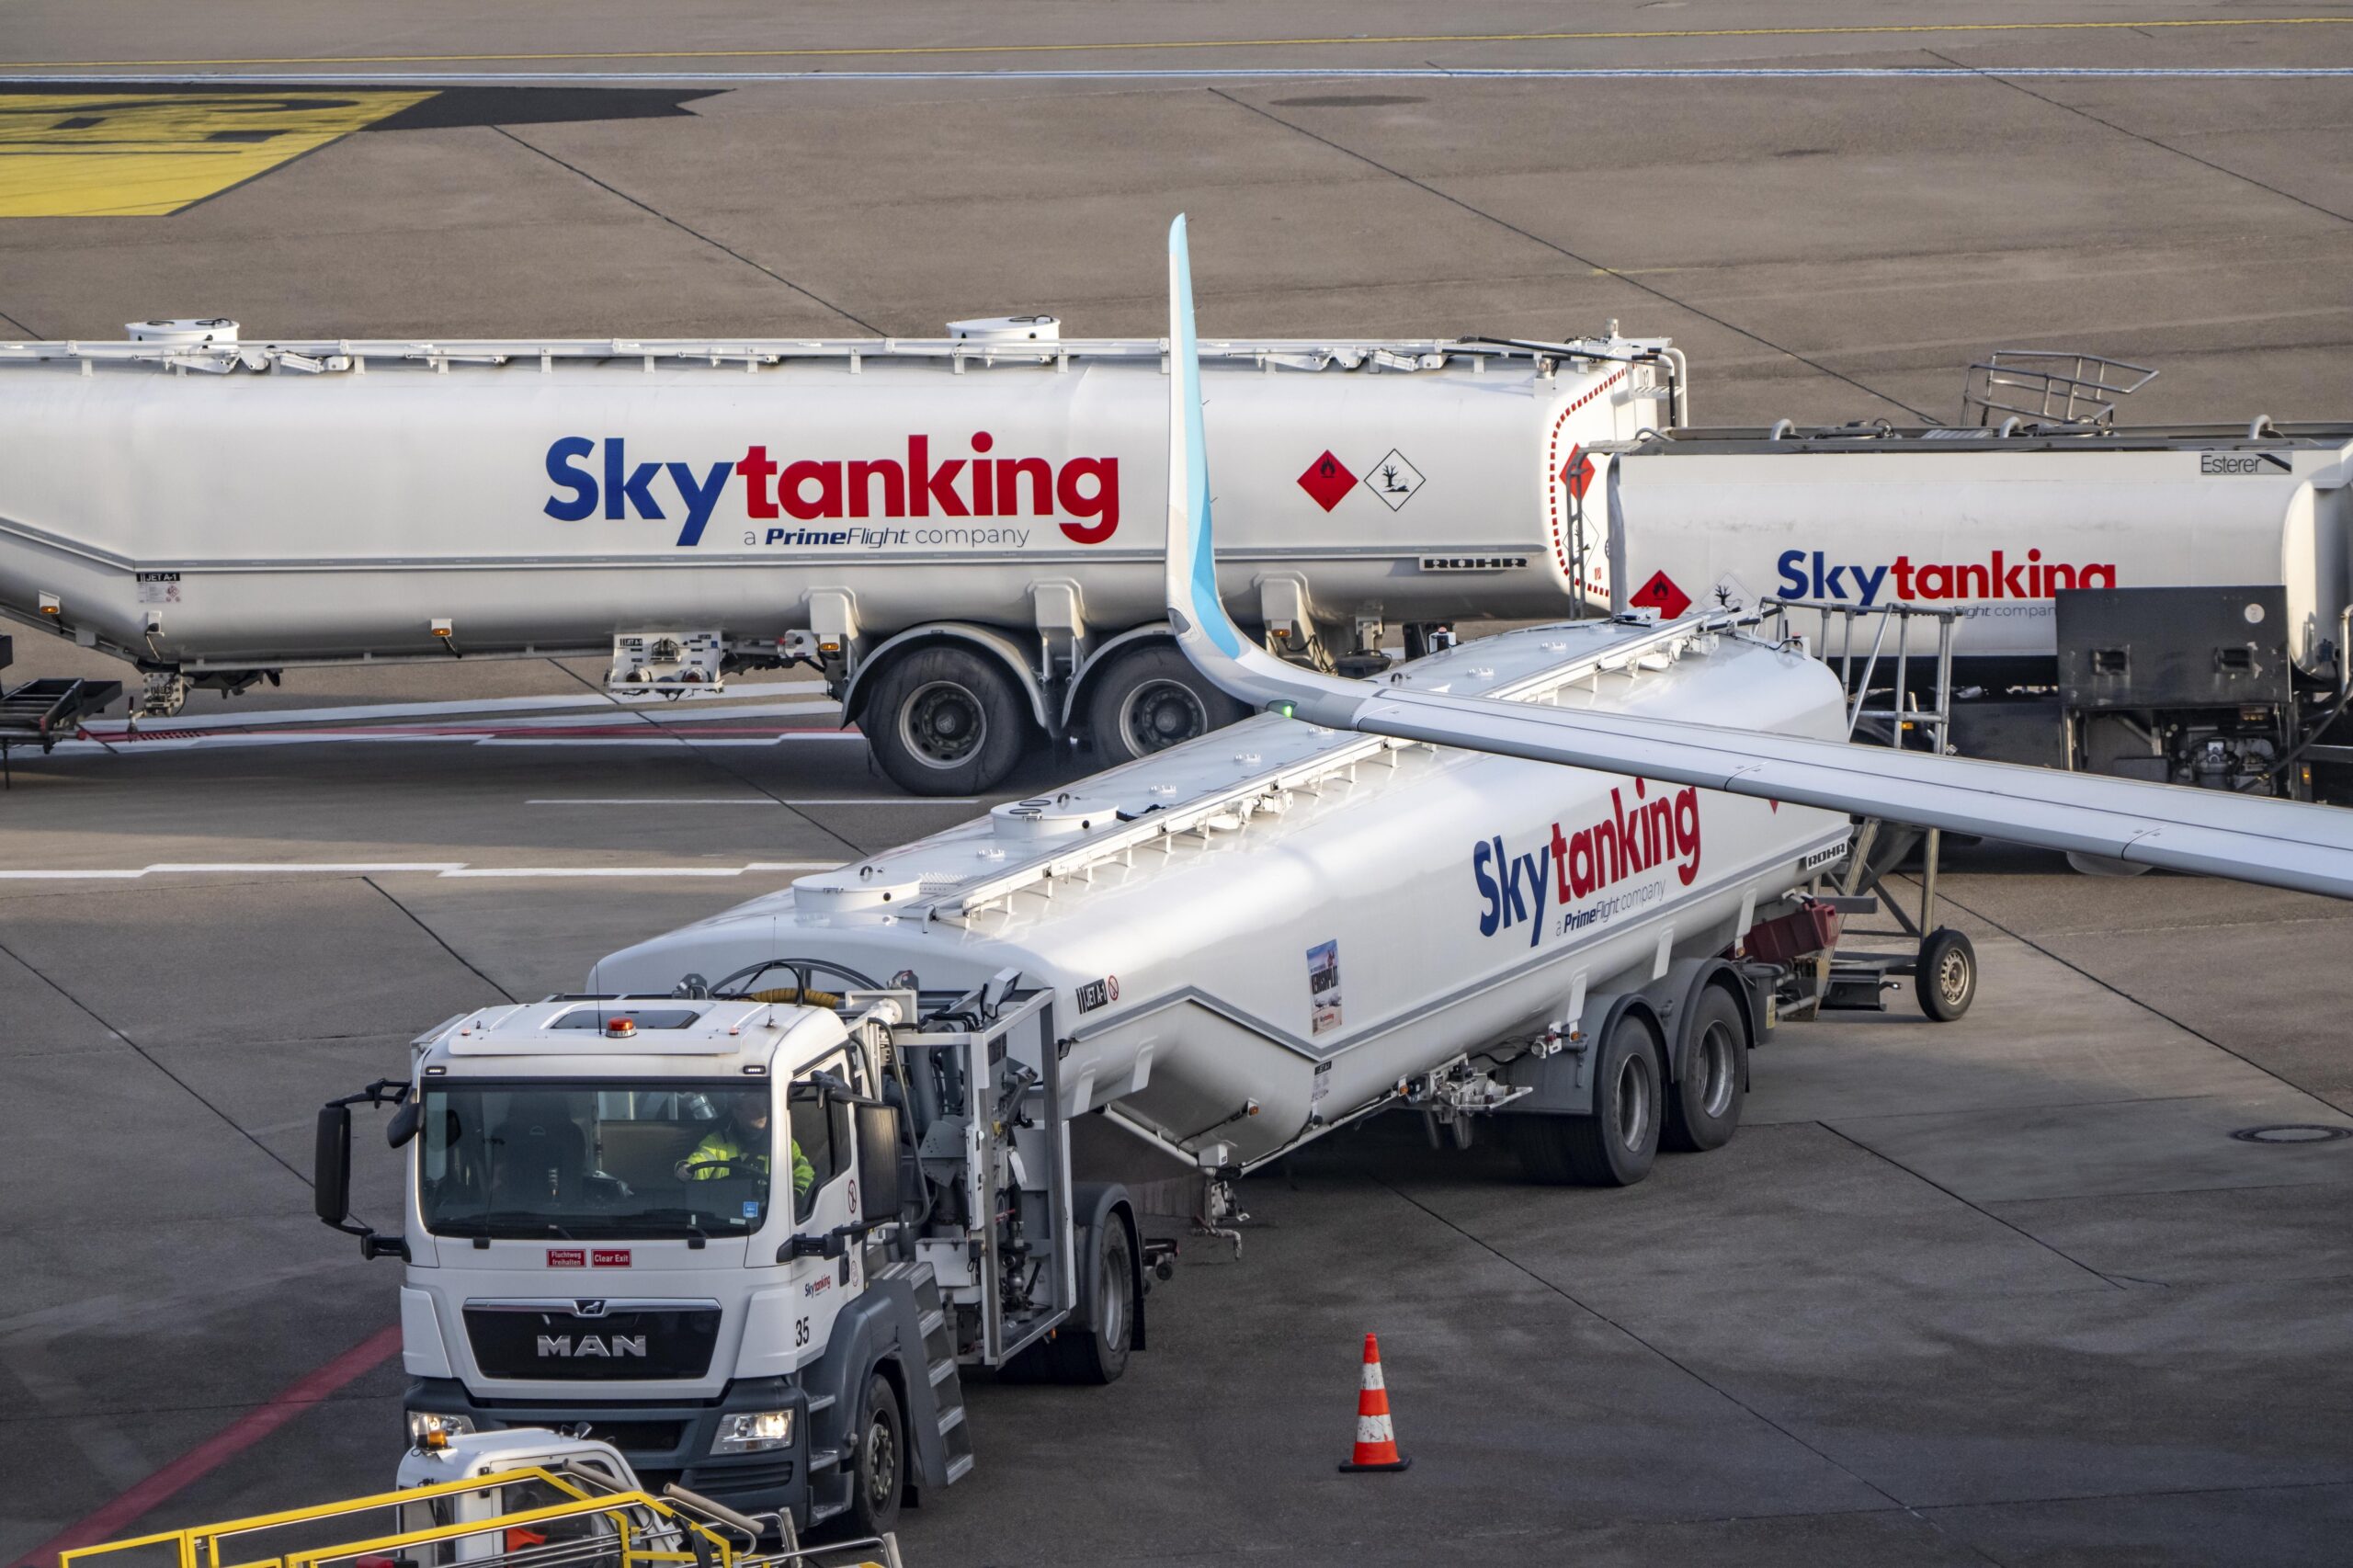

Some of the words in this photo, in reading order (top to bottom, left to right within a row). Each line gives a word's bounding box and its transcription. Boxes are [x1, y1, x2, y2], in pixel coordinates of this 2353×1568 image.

[2200, 455, 2262, 473] Esterer
[543, 431, 1119, 547] Skytanking
[744, 530, 756, 546] a
[765, 527, 911, 550] PrimeFlight
[915, 526, 1030, 549] company
[1424, 558, 1528, 569] ROHR
[147, 574, 161, 582] JET
[164, 574, 176, 582] A-1
[1994, 606, 2056, 619] compan
[1473, 777, 1701, 949] Skytanking
[1808, 843, 1846, 868] ROHR
[1555, 920, 1562, 937] a
[1563, 897, 1620, 934] PrimeFlight
[1621, 878, 1666, 912] company
[1086, 985, 1096, 1007] JET
[1097, 982, 1107, 1004] A-1
[551, 1251, 582, 1259] Fluchtweg
[594, 1255, 613, 1263] Clear
[615, 1254, 629, 1263] Exit
[795, 1316, 810, 1347] 35
[537, 1335, 647, 1357] MAN
